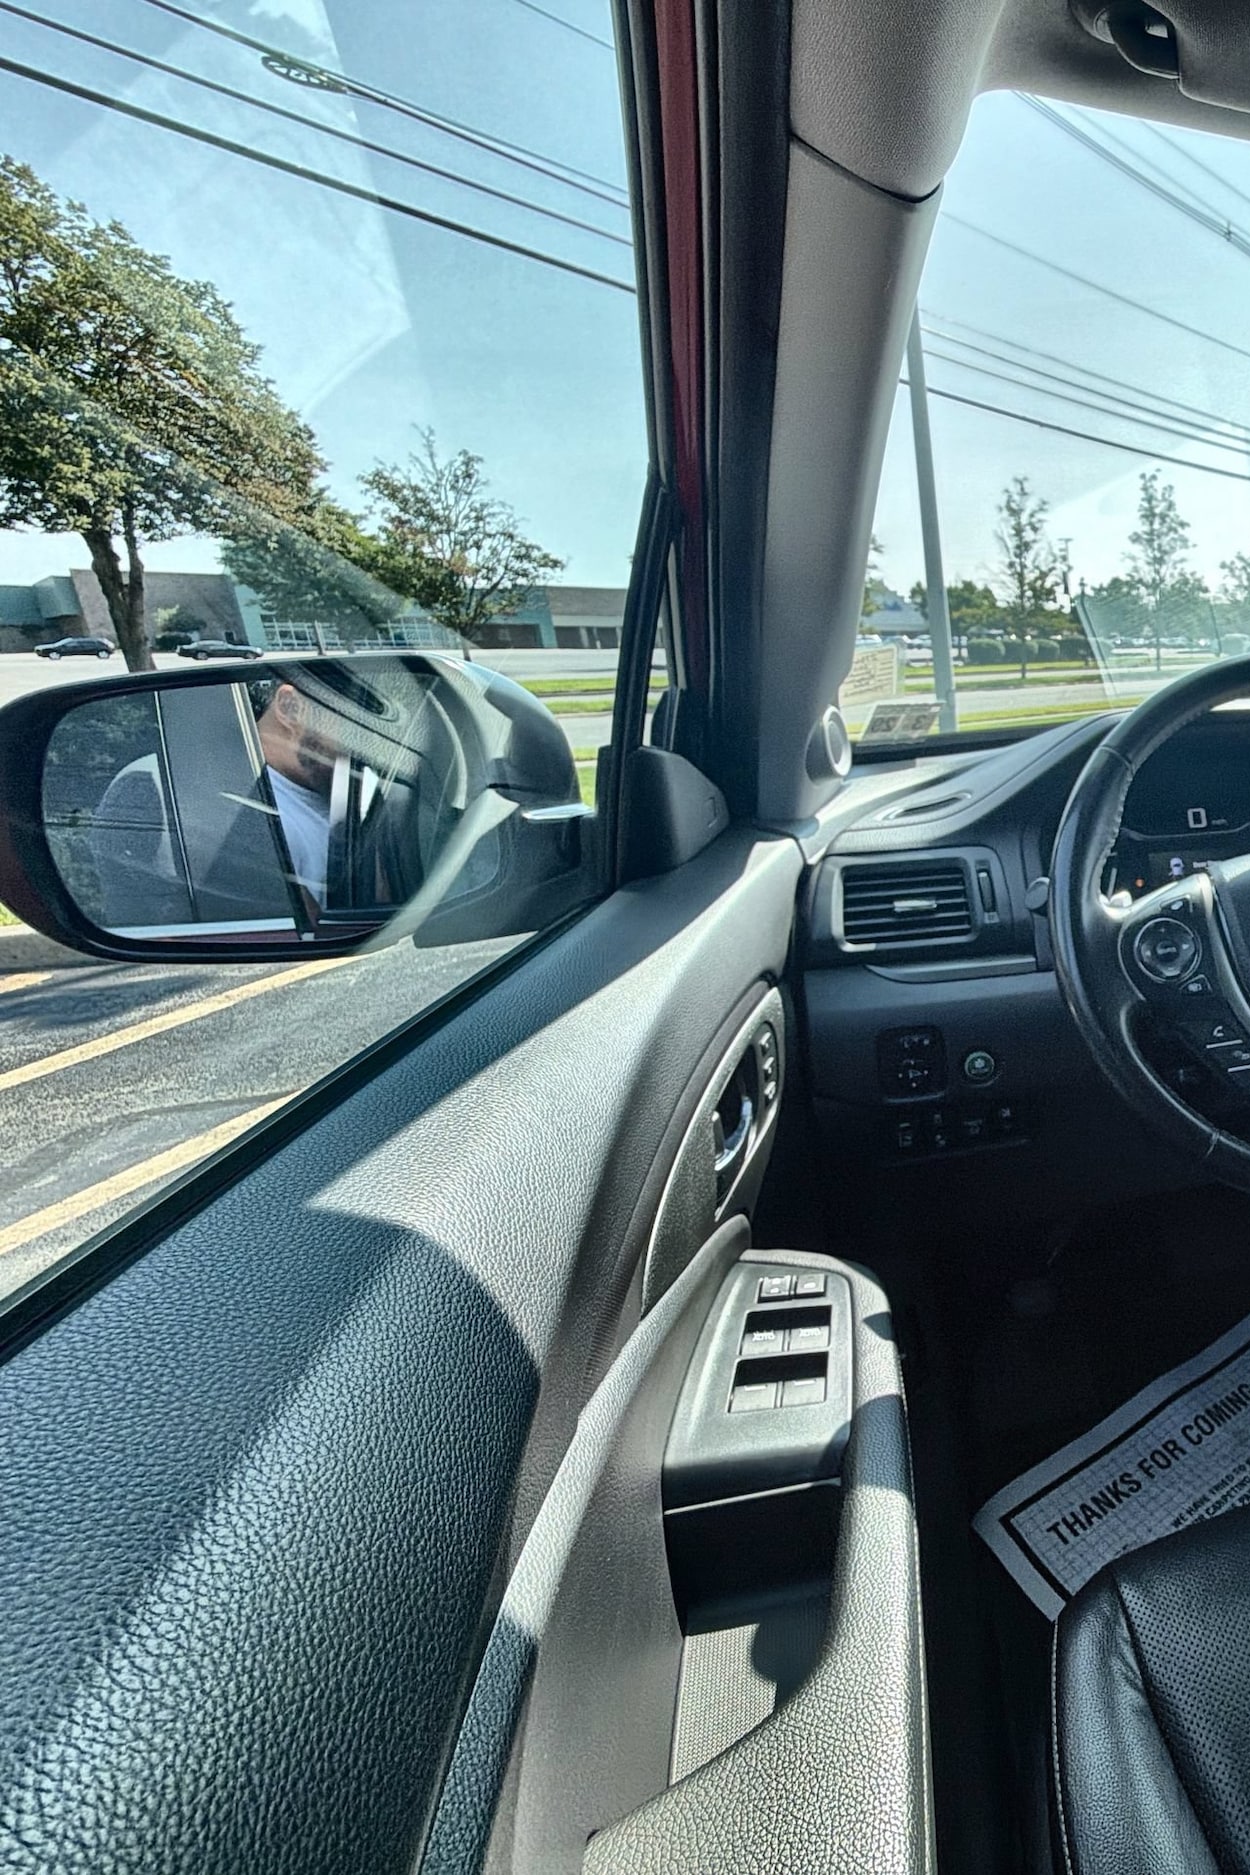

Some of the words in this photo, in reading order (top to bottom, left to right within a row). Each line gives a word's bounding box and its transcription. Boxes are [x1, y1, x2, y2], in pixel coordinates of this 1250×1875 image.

[1187, 807, 1208, 829] 0
[1046, 1471, 1143, 1546] THANKS
[1136, 1438, 1188, 1481] FOR
